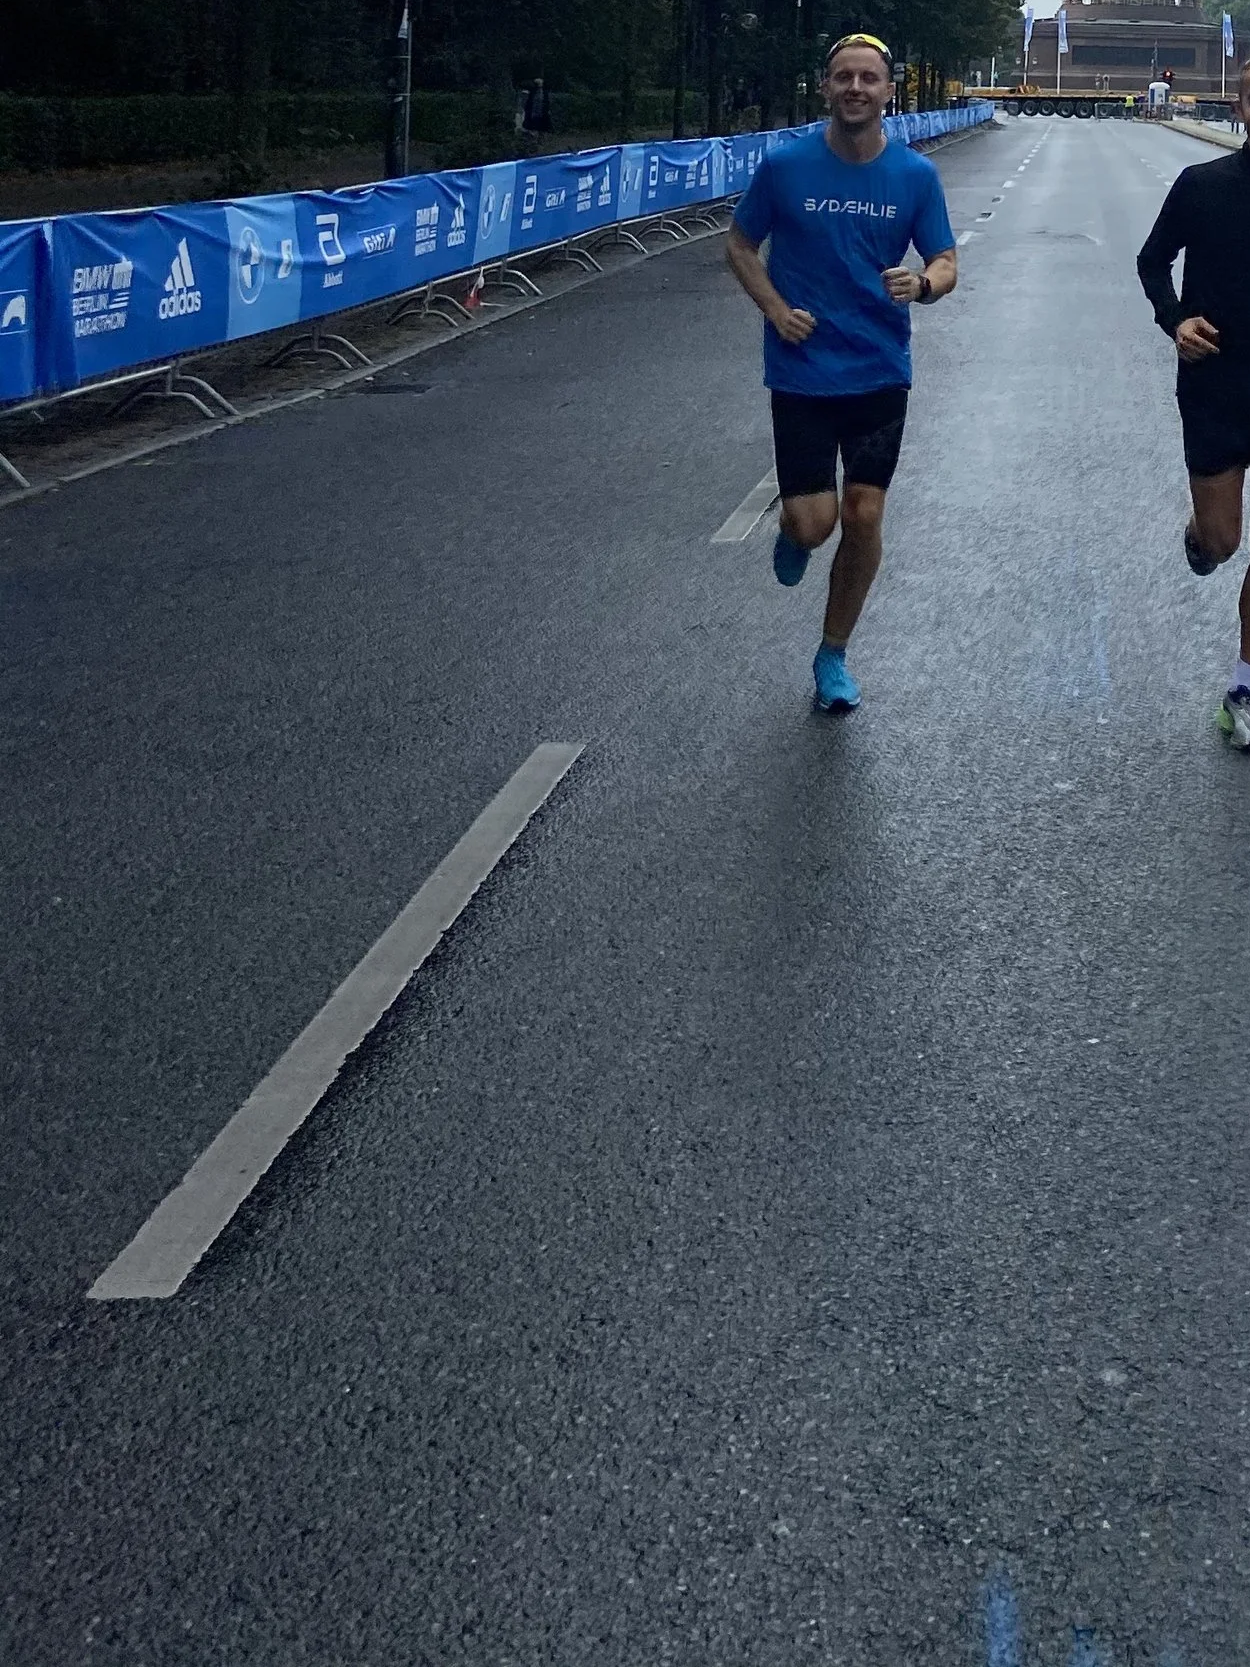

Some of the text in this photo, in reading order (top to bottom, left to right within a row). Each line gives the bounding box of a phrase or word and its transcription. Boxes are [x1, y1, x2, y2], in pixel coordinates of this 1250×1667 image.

[73, 264, 114, 294] BMW
[72, 293, 109, 317] BERLIN
[159, 287, 201, 320] adidas
